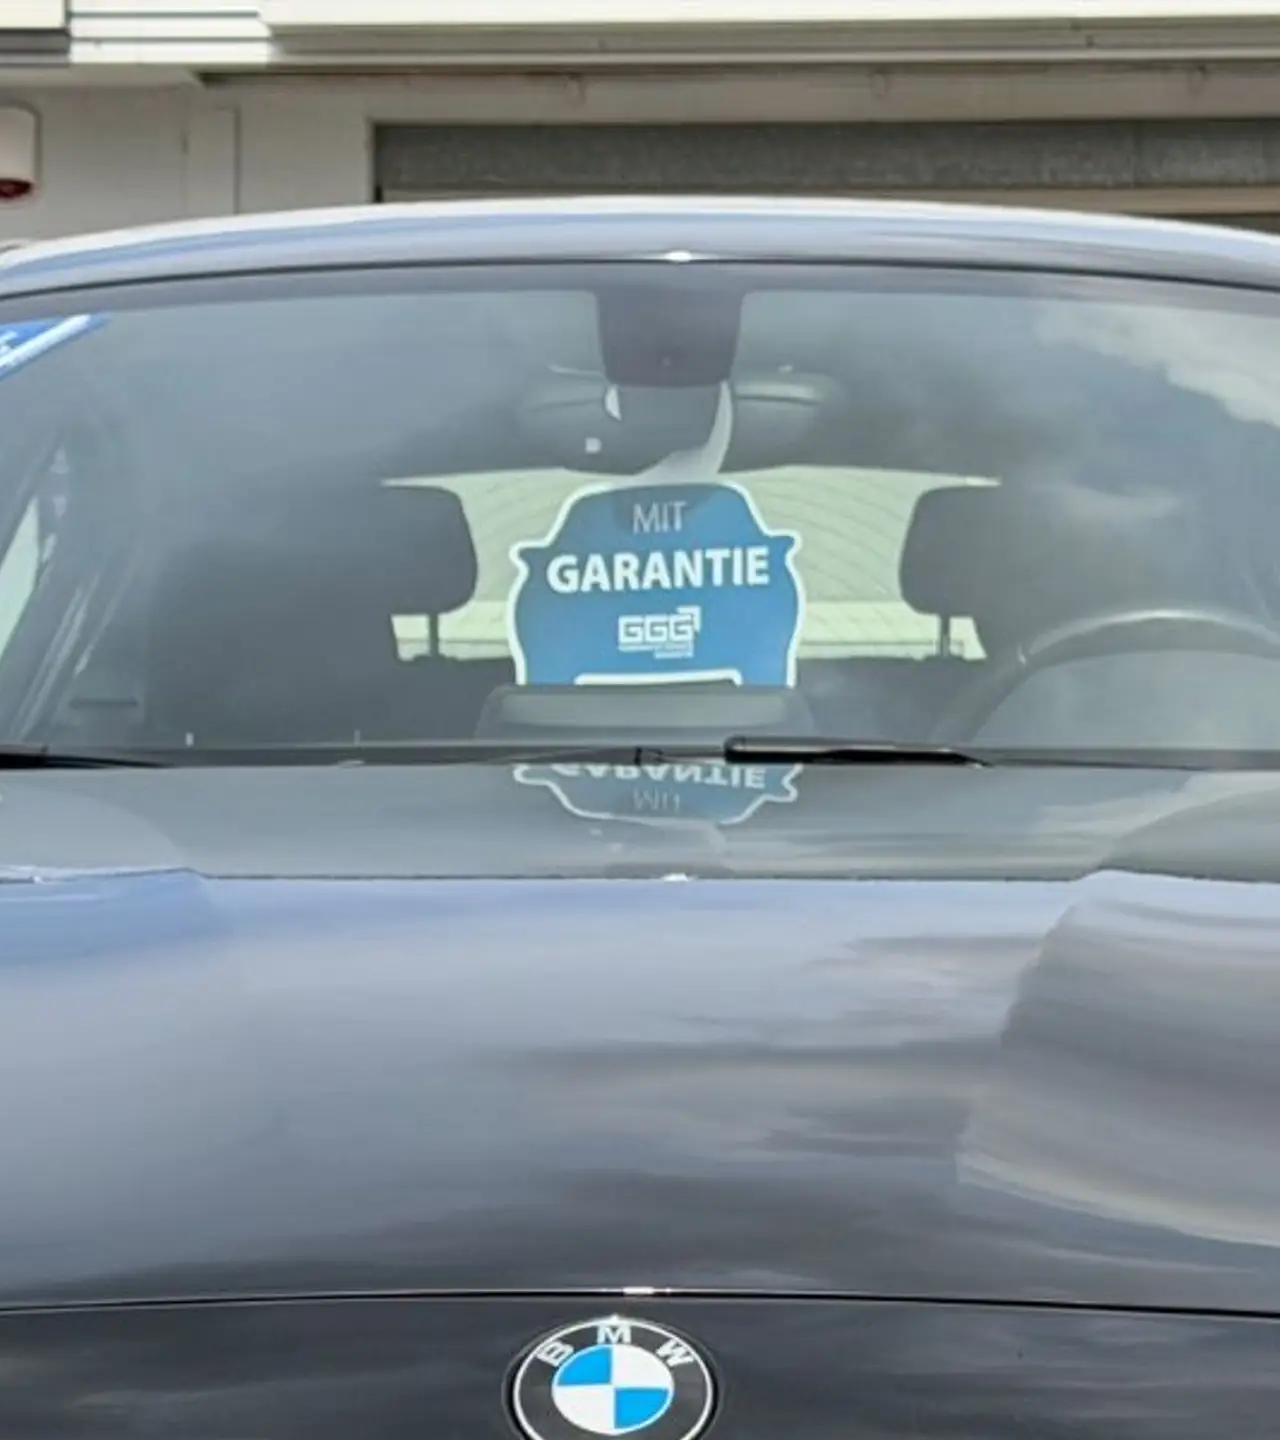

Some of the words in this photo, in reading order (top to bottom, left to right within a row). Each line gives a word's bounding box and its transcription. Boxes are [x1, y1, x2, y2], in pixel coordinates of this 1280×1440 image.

[632, 500, 688, 535] MIT
[546, 546, 770, 594] GARANTIE
[618, 613, 695, 644] GGG
[536, 1322, 694, 1367] BMW
